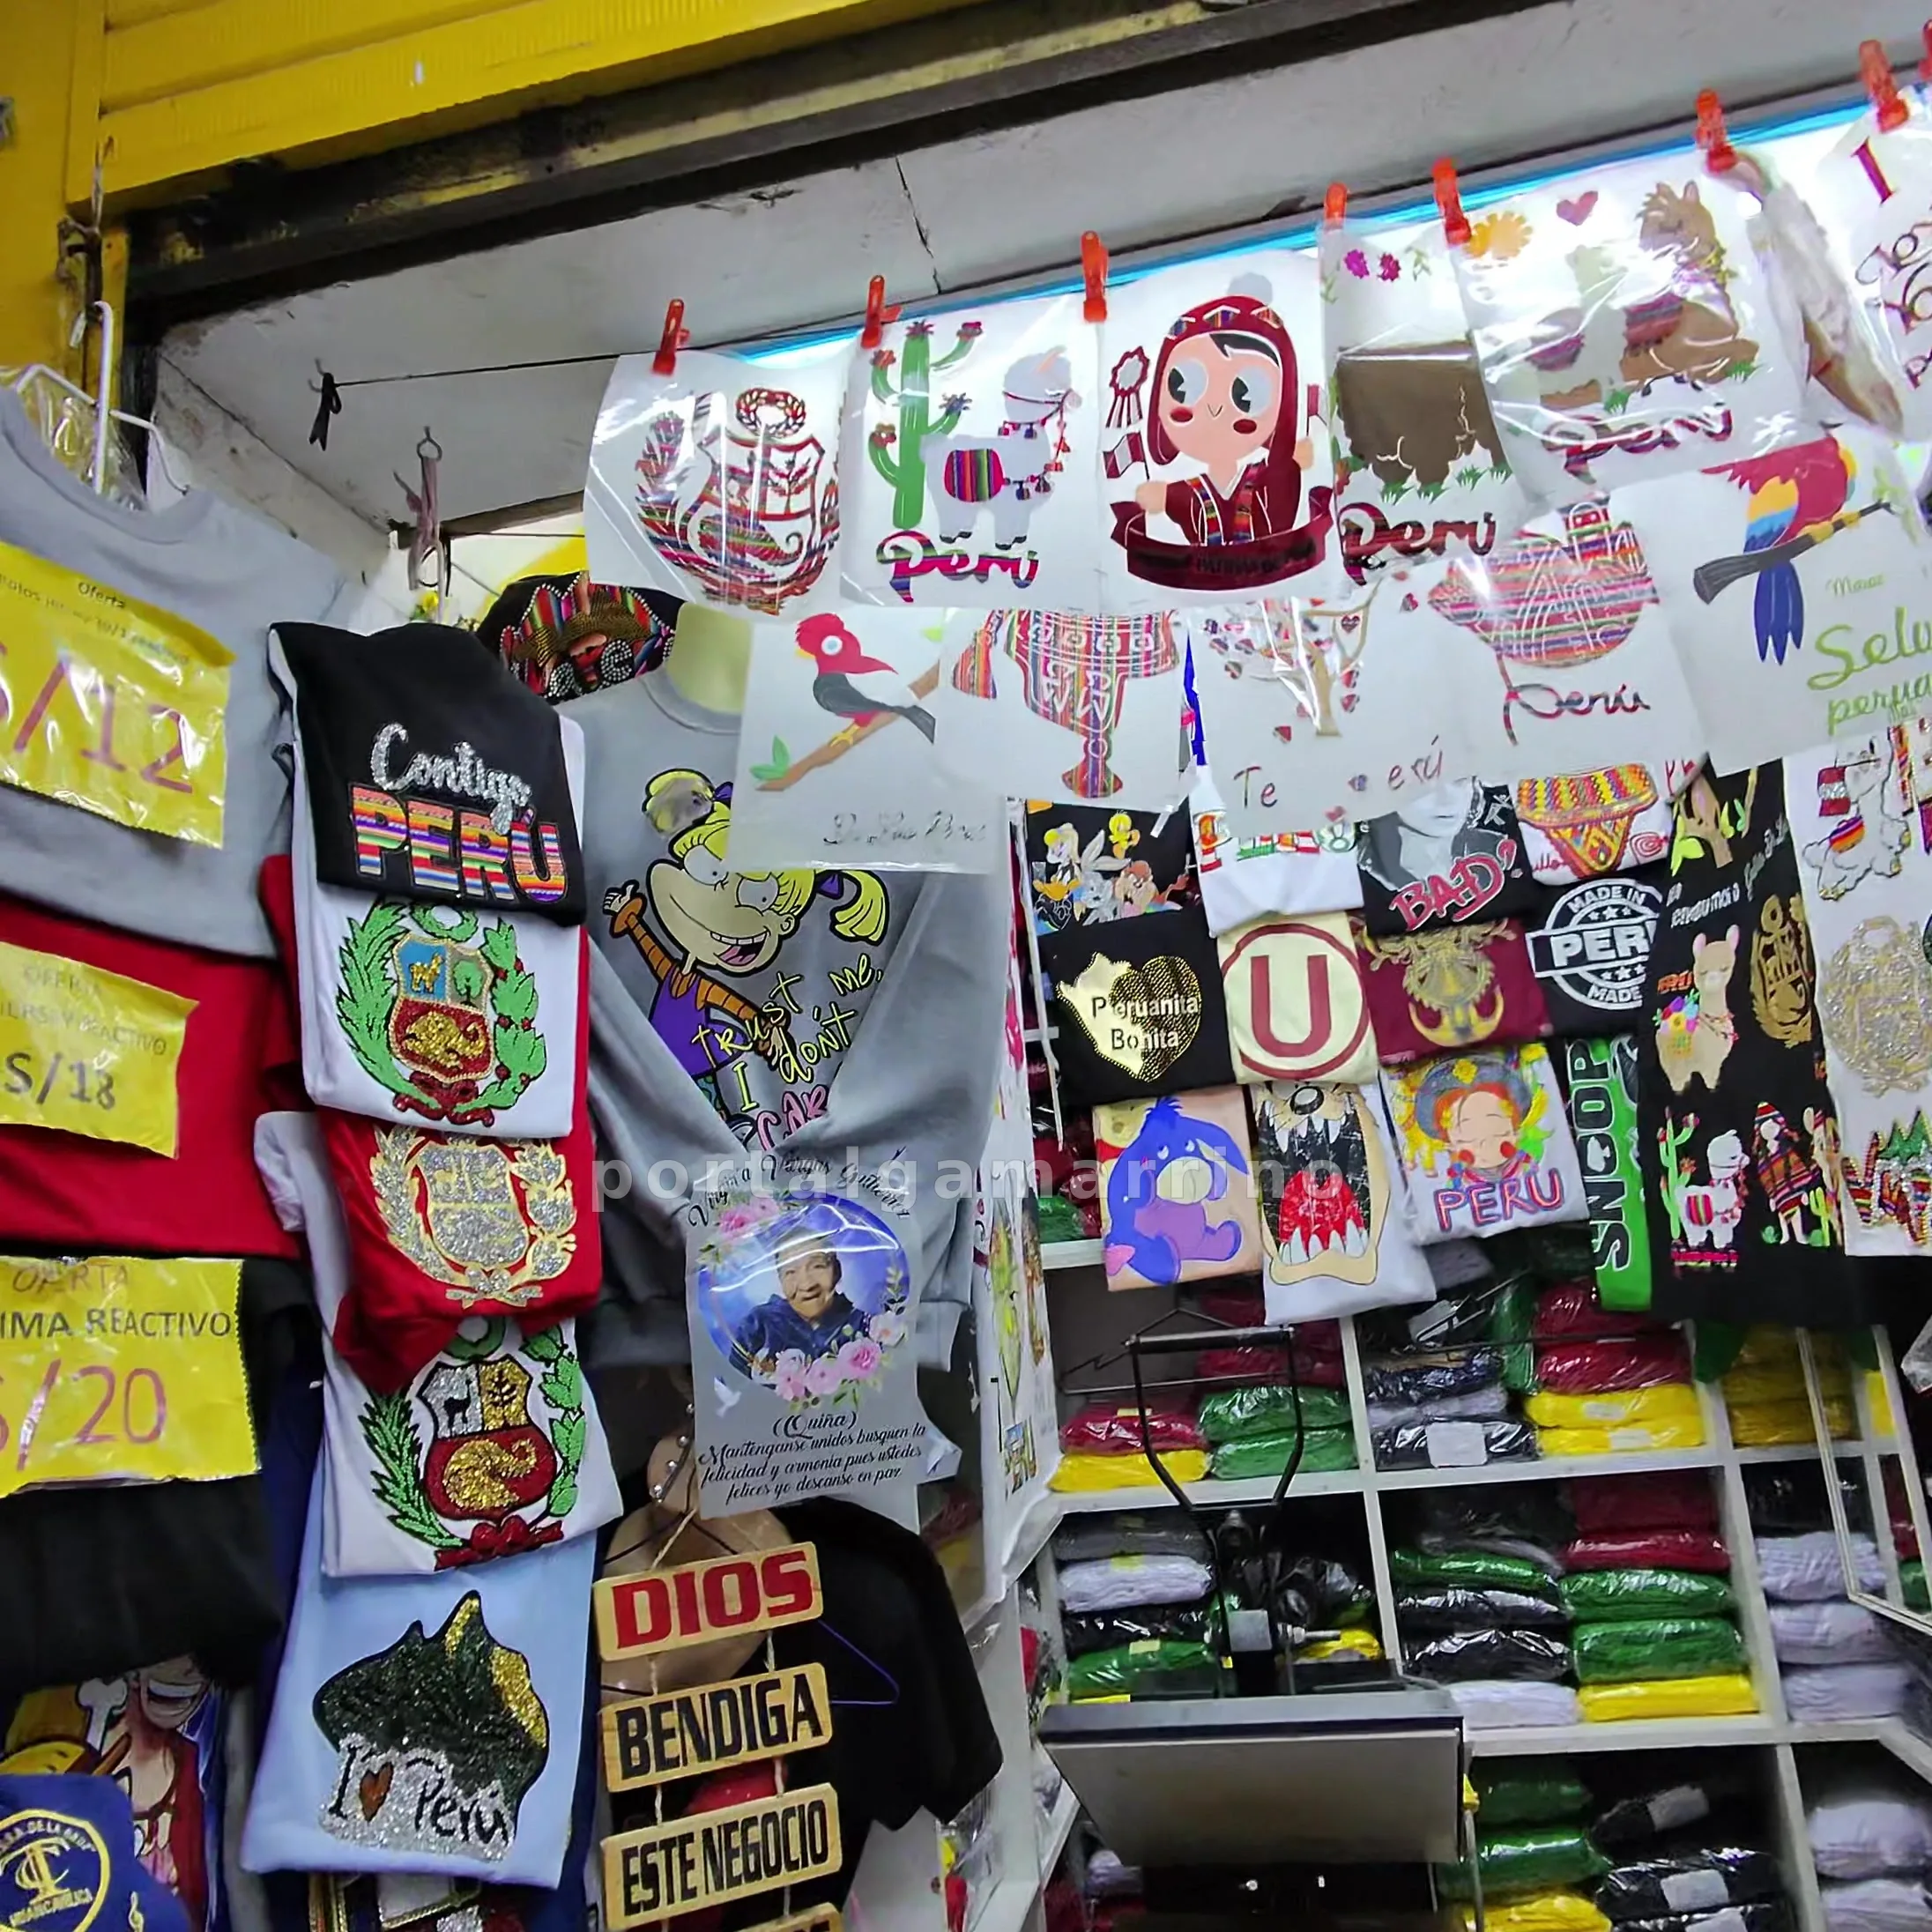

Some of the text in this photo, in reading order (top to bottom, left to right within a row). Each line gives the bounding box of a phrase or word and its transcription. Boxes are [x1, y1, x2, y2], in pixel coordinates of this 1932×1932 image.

[1566, 885, 1624, 913] MADE
[1627, 888, 1646, 907] IN
[1549, 921, 1657, 968] PER
[1091, 992, 1200, 1020] Peruanita
[1250, 954, 1333, 1059] U
[1586, 983, 1643, 1004] MADE
[1111, 1026, 1180, 1051] Bonita
[4, 1051, 116, 1111] S/18
[1434, 1167, 1565, 1233] PERU
[85, 1308, 233, 1338] REACTIVO
[810, 1430, 854, 1450] unidos
[856, 1427, 909, 1446] busquen
[700, 1460, 768, 1490] felicidad
[843, 1451, 875, 1472] pues
[877, 1443, 922, 1462] ustedes
[725, 1481, 770, 1506] felices
[774, 1482, 791, 1501] yo
[795, 1474, 853, 1492] descanso
[858, 1470, 872, 1483] en
[612, 1549, 814, 1650] DIOS
[615, 1673, 824, 1780] BENDIGA
[621, 1799, 829, 1917] ESTE NEGOCIO
